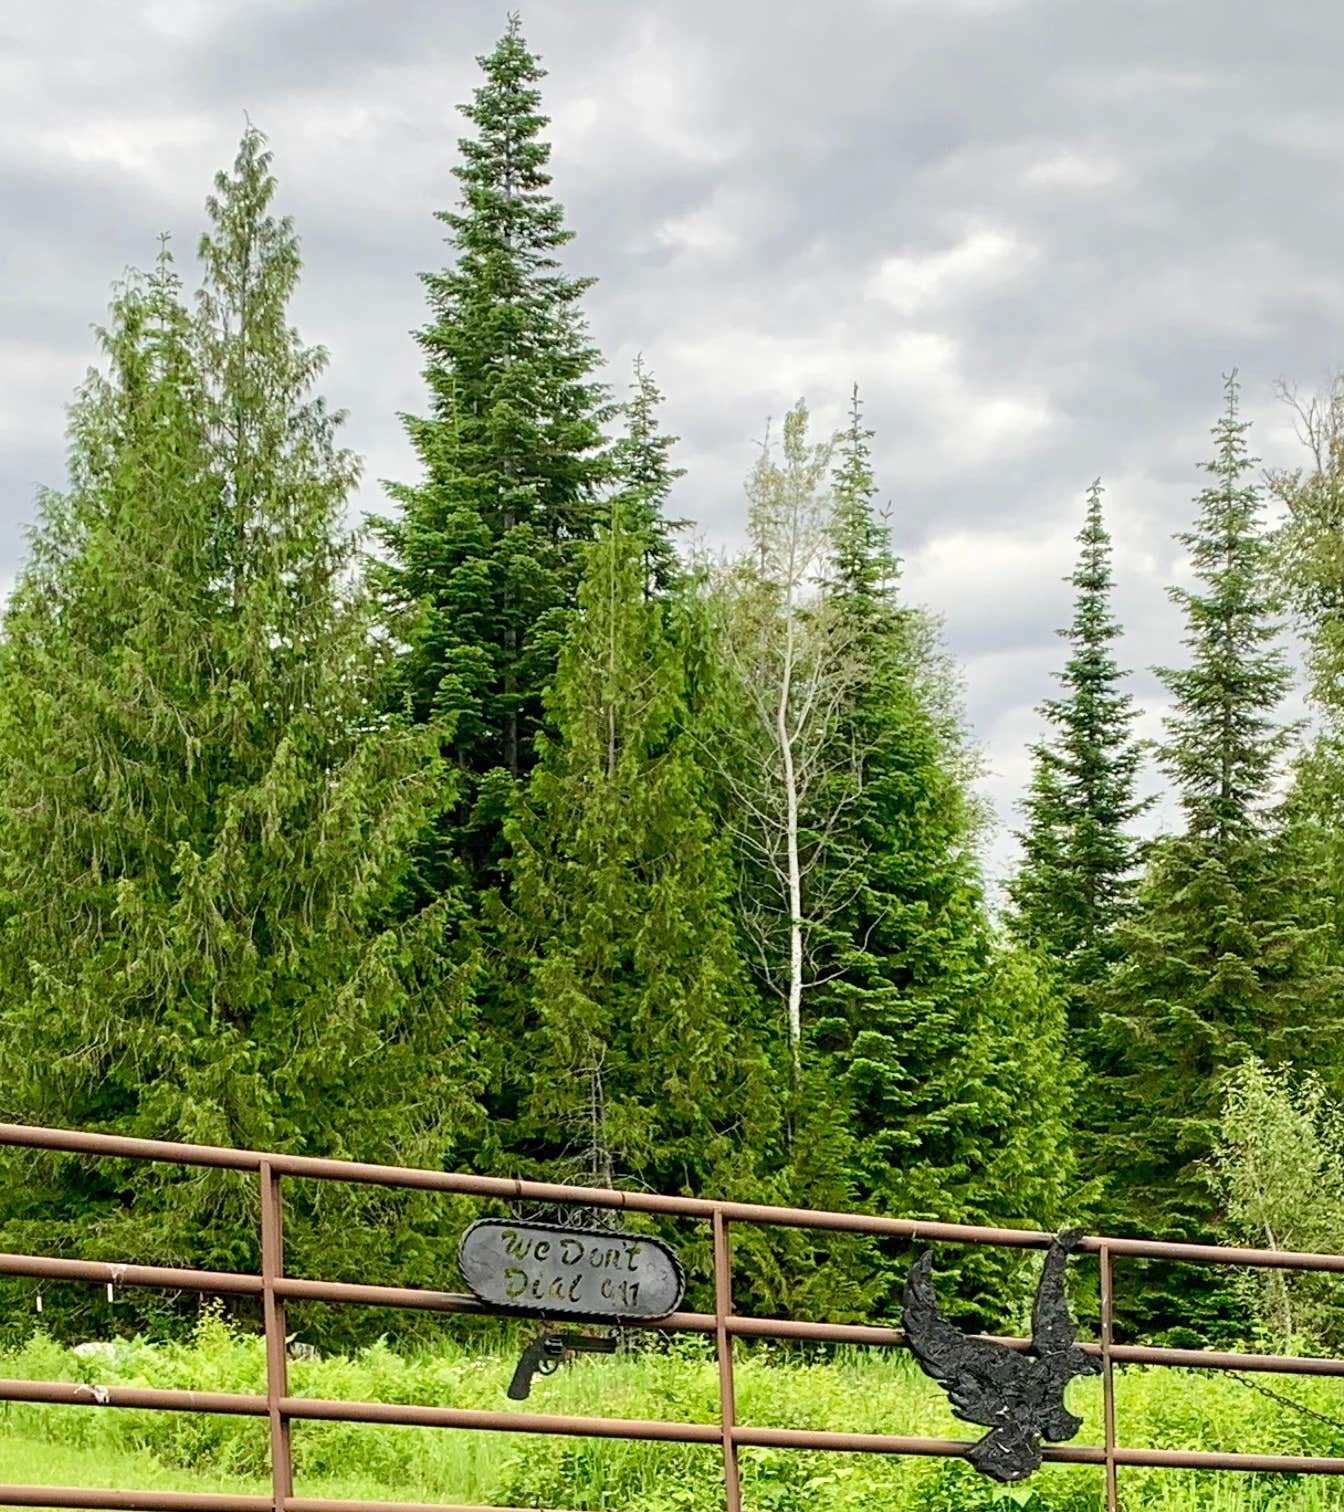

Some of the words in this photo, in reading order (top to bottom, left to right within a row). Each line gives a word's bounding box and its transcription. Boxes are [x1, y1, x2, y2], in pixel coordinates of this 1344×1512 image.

[501, 1229, 551, 1261] We
[560, 1238, 641, 1272] Don't
[503, 1266, 582, 1303] Dial
